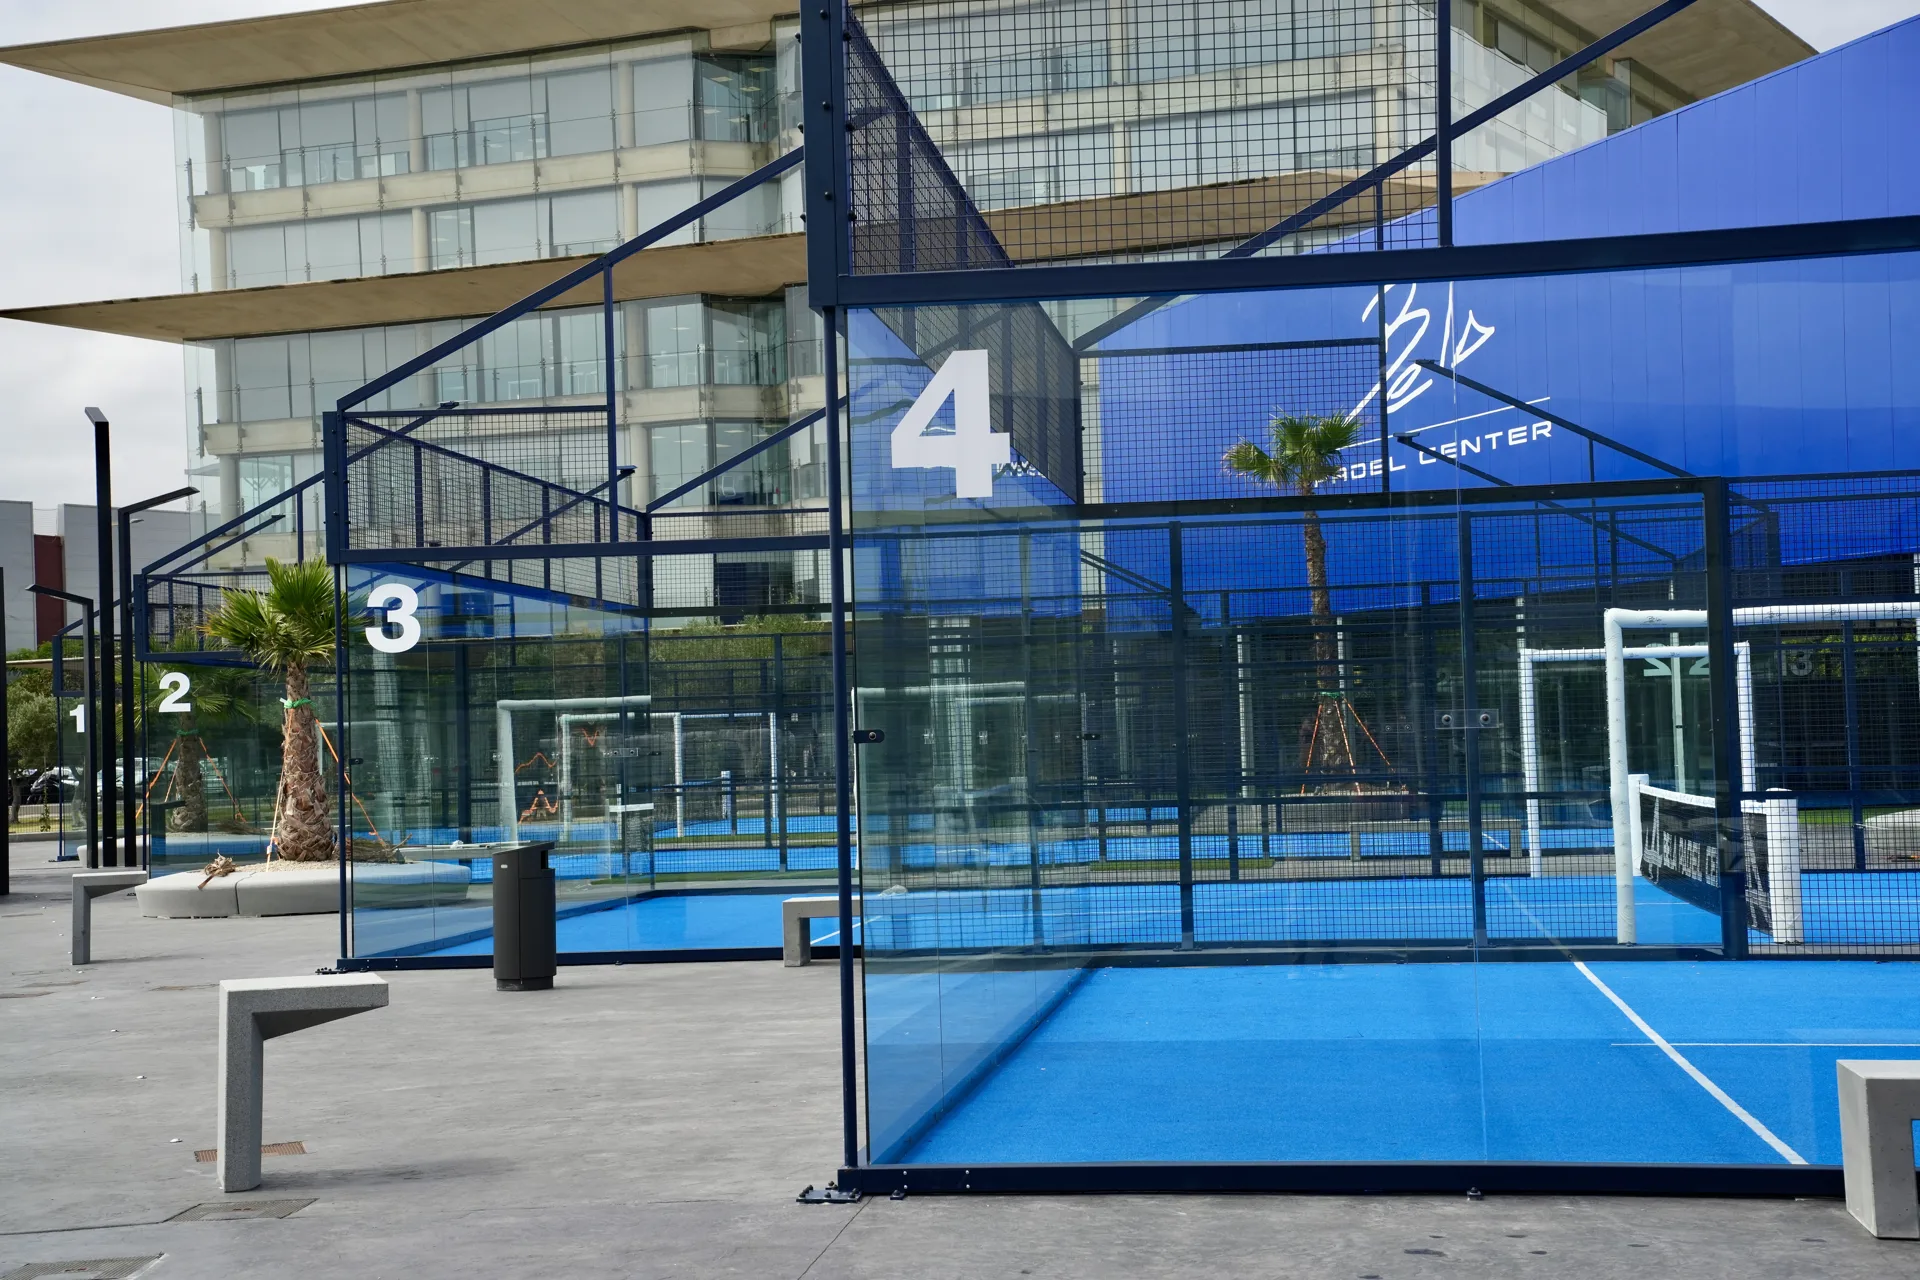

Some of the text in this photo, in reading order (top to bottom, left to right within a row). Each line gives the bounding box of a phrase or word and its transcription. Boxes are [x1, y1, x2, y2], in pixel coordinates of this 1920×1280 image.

[891, 349, 1010, 498] 4
[1419, 421, 1552, 465] CENTER
[365, 583, 421, 654] 3
[158, 672, 192, 713] 2
[69, 704, 85, 733] 1
